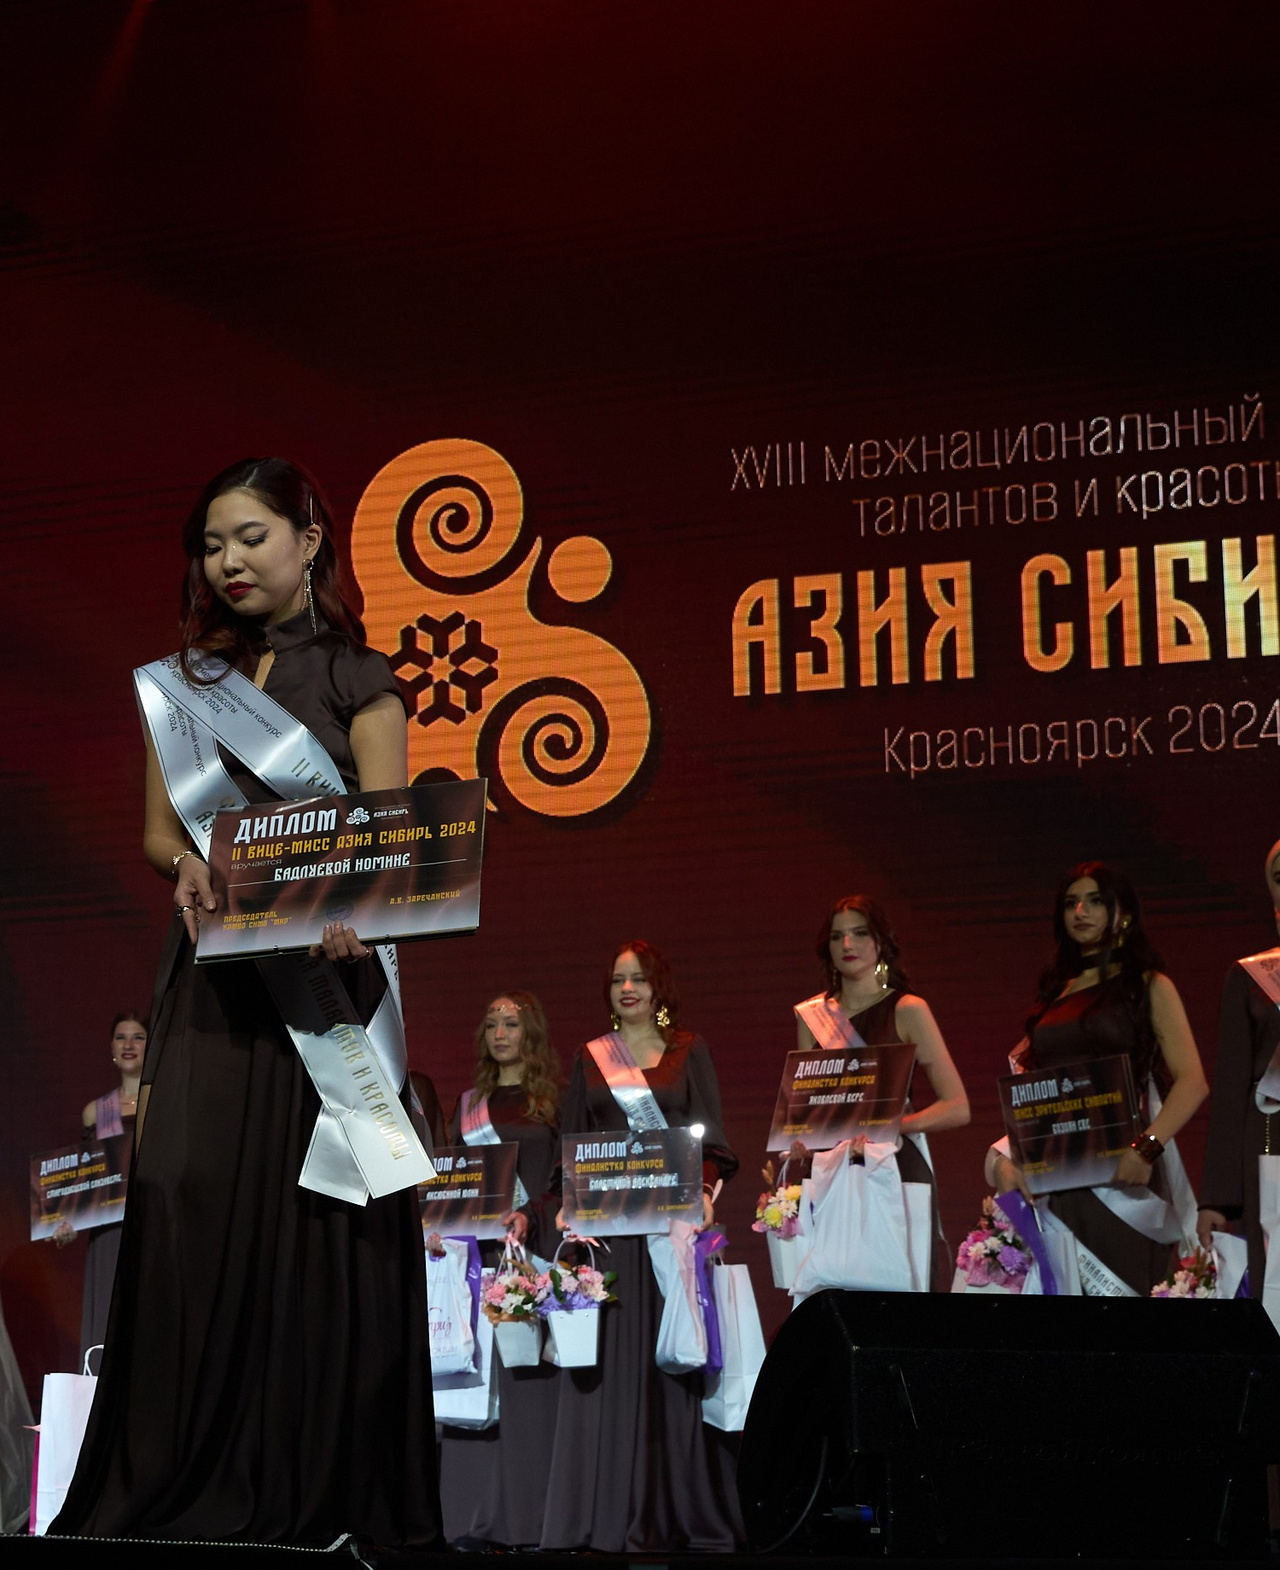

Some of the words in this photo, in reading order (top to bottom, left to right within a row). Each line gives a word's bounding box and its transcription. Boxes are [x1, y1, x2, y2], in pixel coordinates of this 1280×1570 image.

[730, 441, 806, 491] XVIII
[825, 393, 1265, 482] межнациональный
[852, 481, 1058, 537] талантов
[1075, 476, 1100, 518] и
[1116, 460, 1280, 520] красот
[731, 560, 976, 697] АЗИЯ
[1020, 534, 1280, 673] СИБИ
[205, 698, 223, 715] 2024
[209, 691, 239, 714] красоты
[167, 712, 178, 732] 2024
[254, 713, 282, 738] конкурс
[884, 716, 1153, 780] Красноярск
[1168, 698, 1280, 754] 2024
[193, 742, 207, 777] конкурс
[291, 757, 311, 778] II
[234, 808, 337, 844] ДИПЛОМ
[231, 847, 241, 861] II
[247, 836, 330, 860] ВИЦЕ-МИСС
[336, 832, 372, 849] АЗИЯ
[379, 826, 433, 844] СИБИРЬ
[439, 820, 477, 838] 2024
[230, 858, 282, 871] вручается
[273, 858, 350, 882] БАДЛУЕВОЙ
[355, 852, 411, 873] НОМИНЕ
[794, 1059, 845, 1079] ДИПЛОМ
[792, 1077, 838, 1090] ФИНАЛИСТКА
[840, 1075, 876, 1087] КОНКУРСА
[1011, 1079, 1059, 1107] ДИПЛОМ
[638, 1095, 661, 1130] ИНАЛИС
[575, 1141, 627, 1162] ДИПЛОМ
[40, 1153, 79, 1176] ДИПЛОМ
[575, 1161, 624, 1175] ФИНАЛИСТКА
[626, 1159, 664, 1171] КОНКУРСА
[450, 1172, 482, 1184] КОНКУРСА
